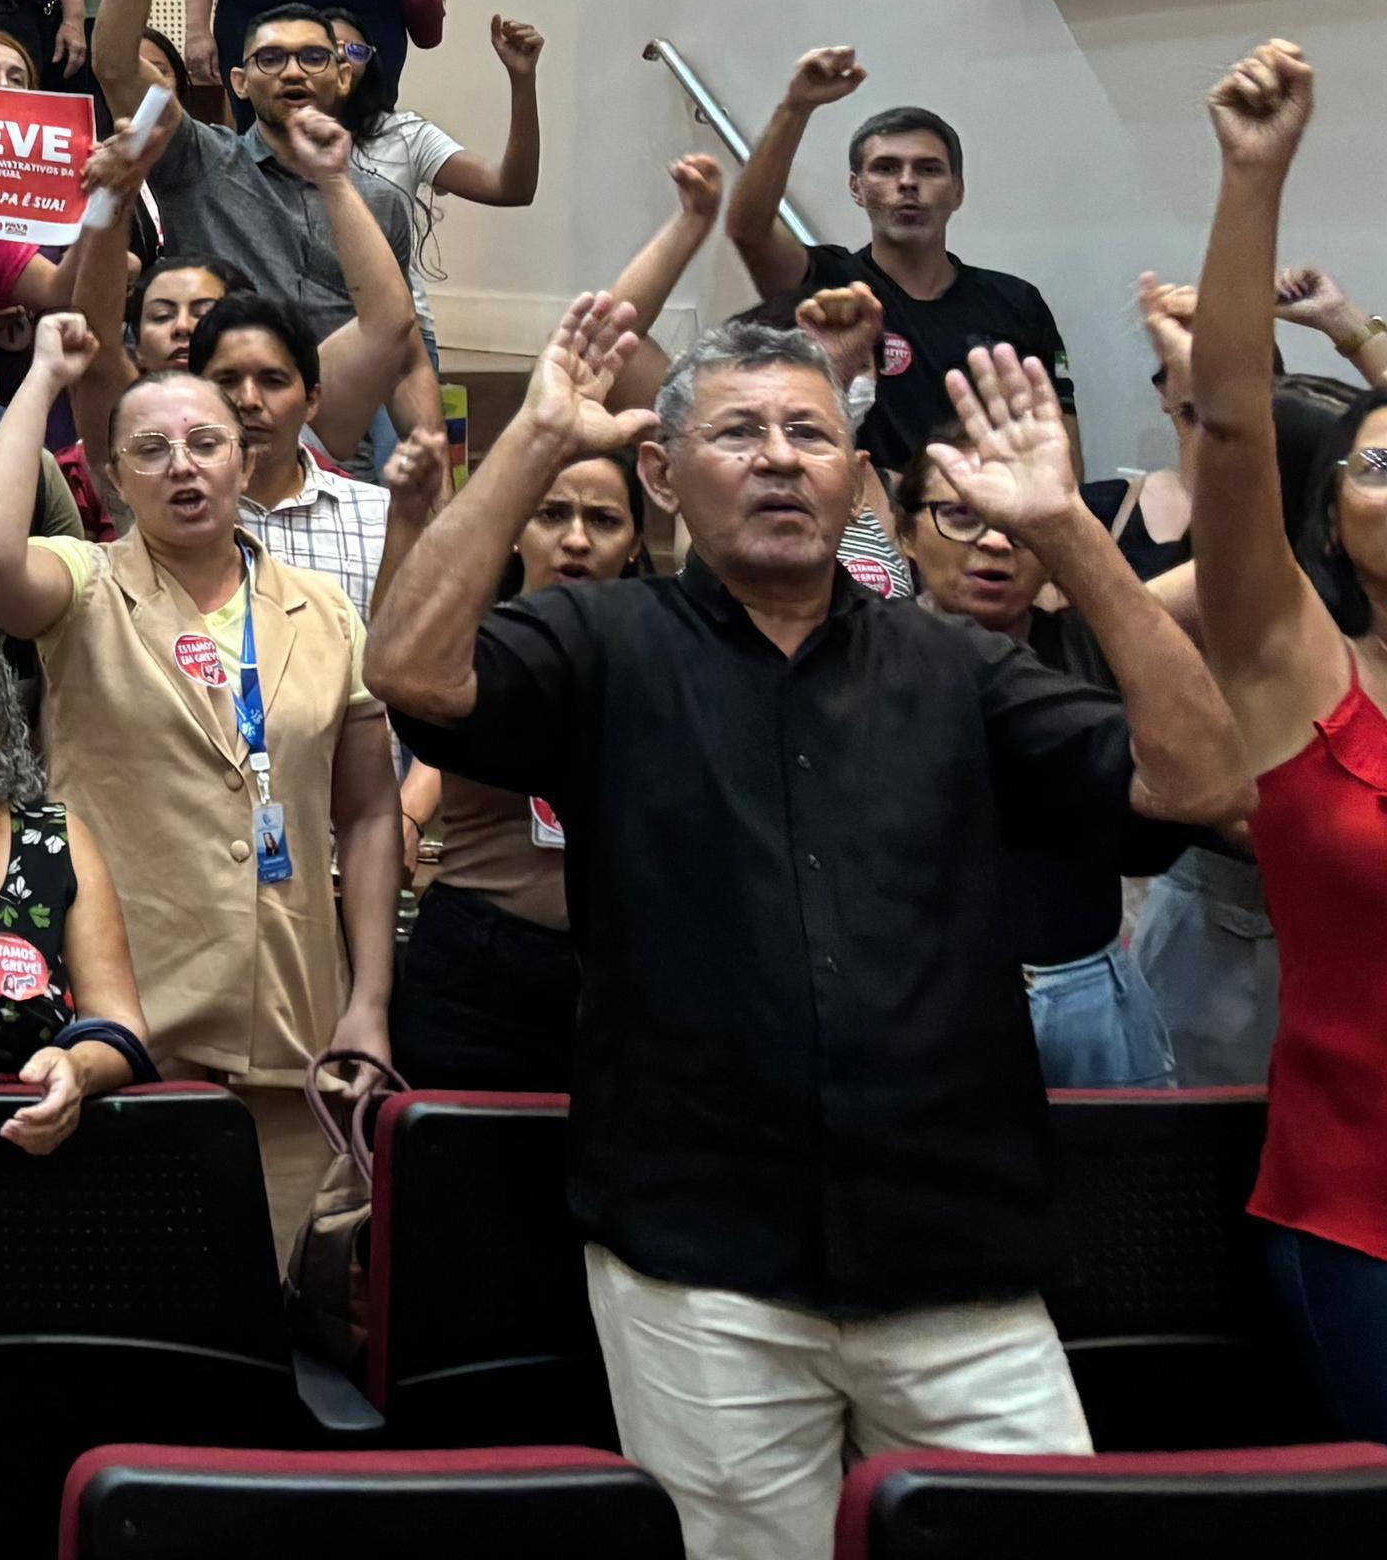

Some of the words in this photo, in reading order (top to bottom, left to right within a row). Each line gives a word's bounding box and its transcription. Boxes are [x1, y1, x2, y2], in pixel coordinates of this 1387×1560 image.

[61, 166, 75, 178] DA
[22, 193, 32, 208] É
[34, 196, 66, 213] SUA!
[1, 958, 42, 975] GREVE!
